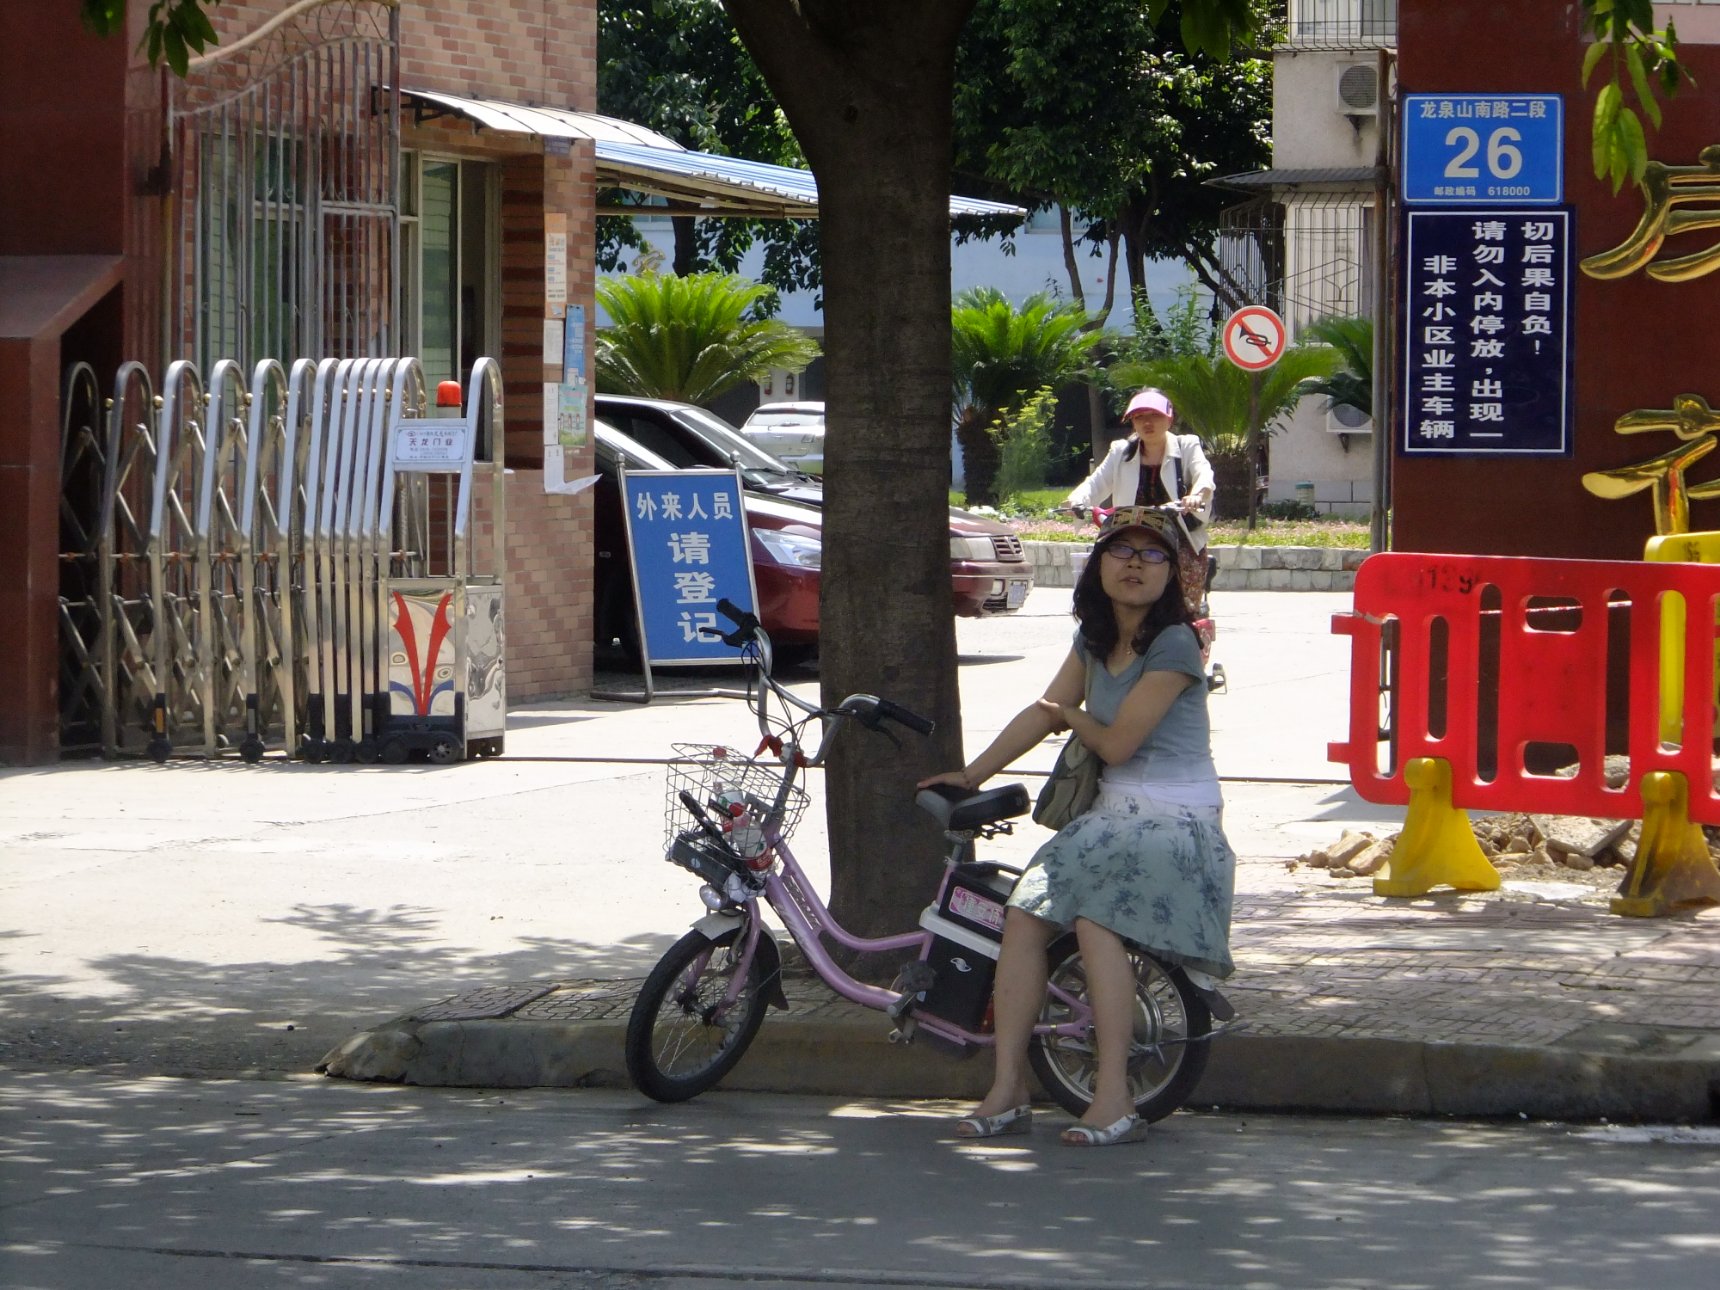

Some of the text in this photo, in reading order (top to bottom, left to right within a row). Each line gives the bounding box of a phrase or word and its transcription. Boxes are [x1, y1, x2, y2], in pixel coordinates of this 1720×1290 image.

[1420, 101, 1546, 118] 龙泉山南路二段
[1444, 127, 1522, 179] 26
[1434, 186, 1530, 196] 邮政编码 618000
[1420, 254, 1457, 439] 非本小区业主车辆
[636, 492, 733, 521] 外来人员
[667, 531, 722, 643] 请登记
